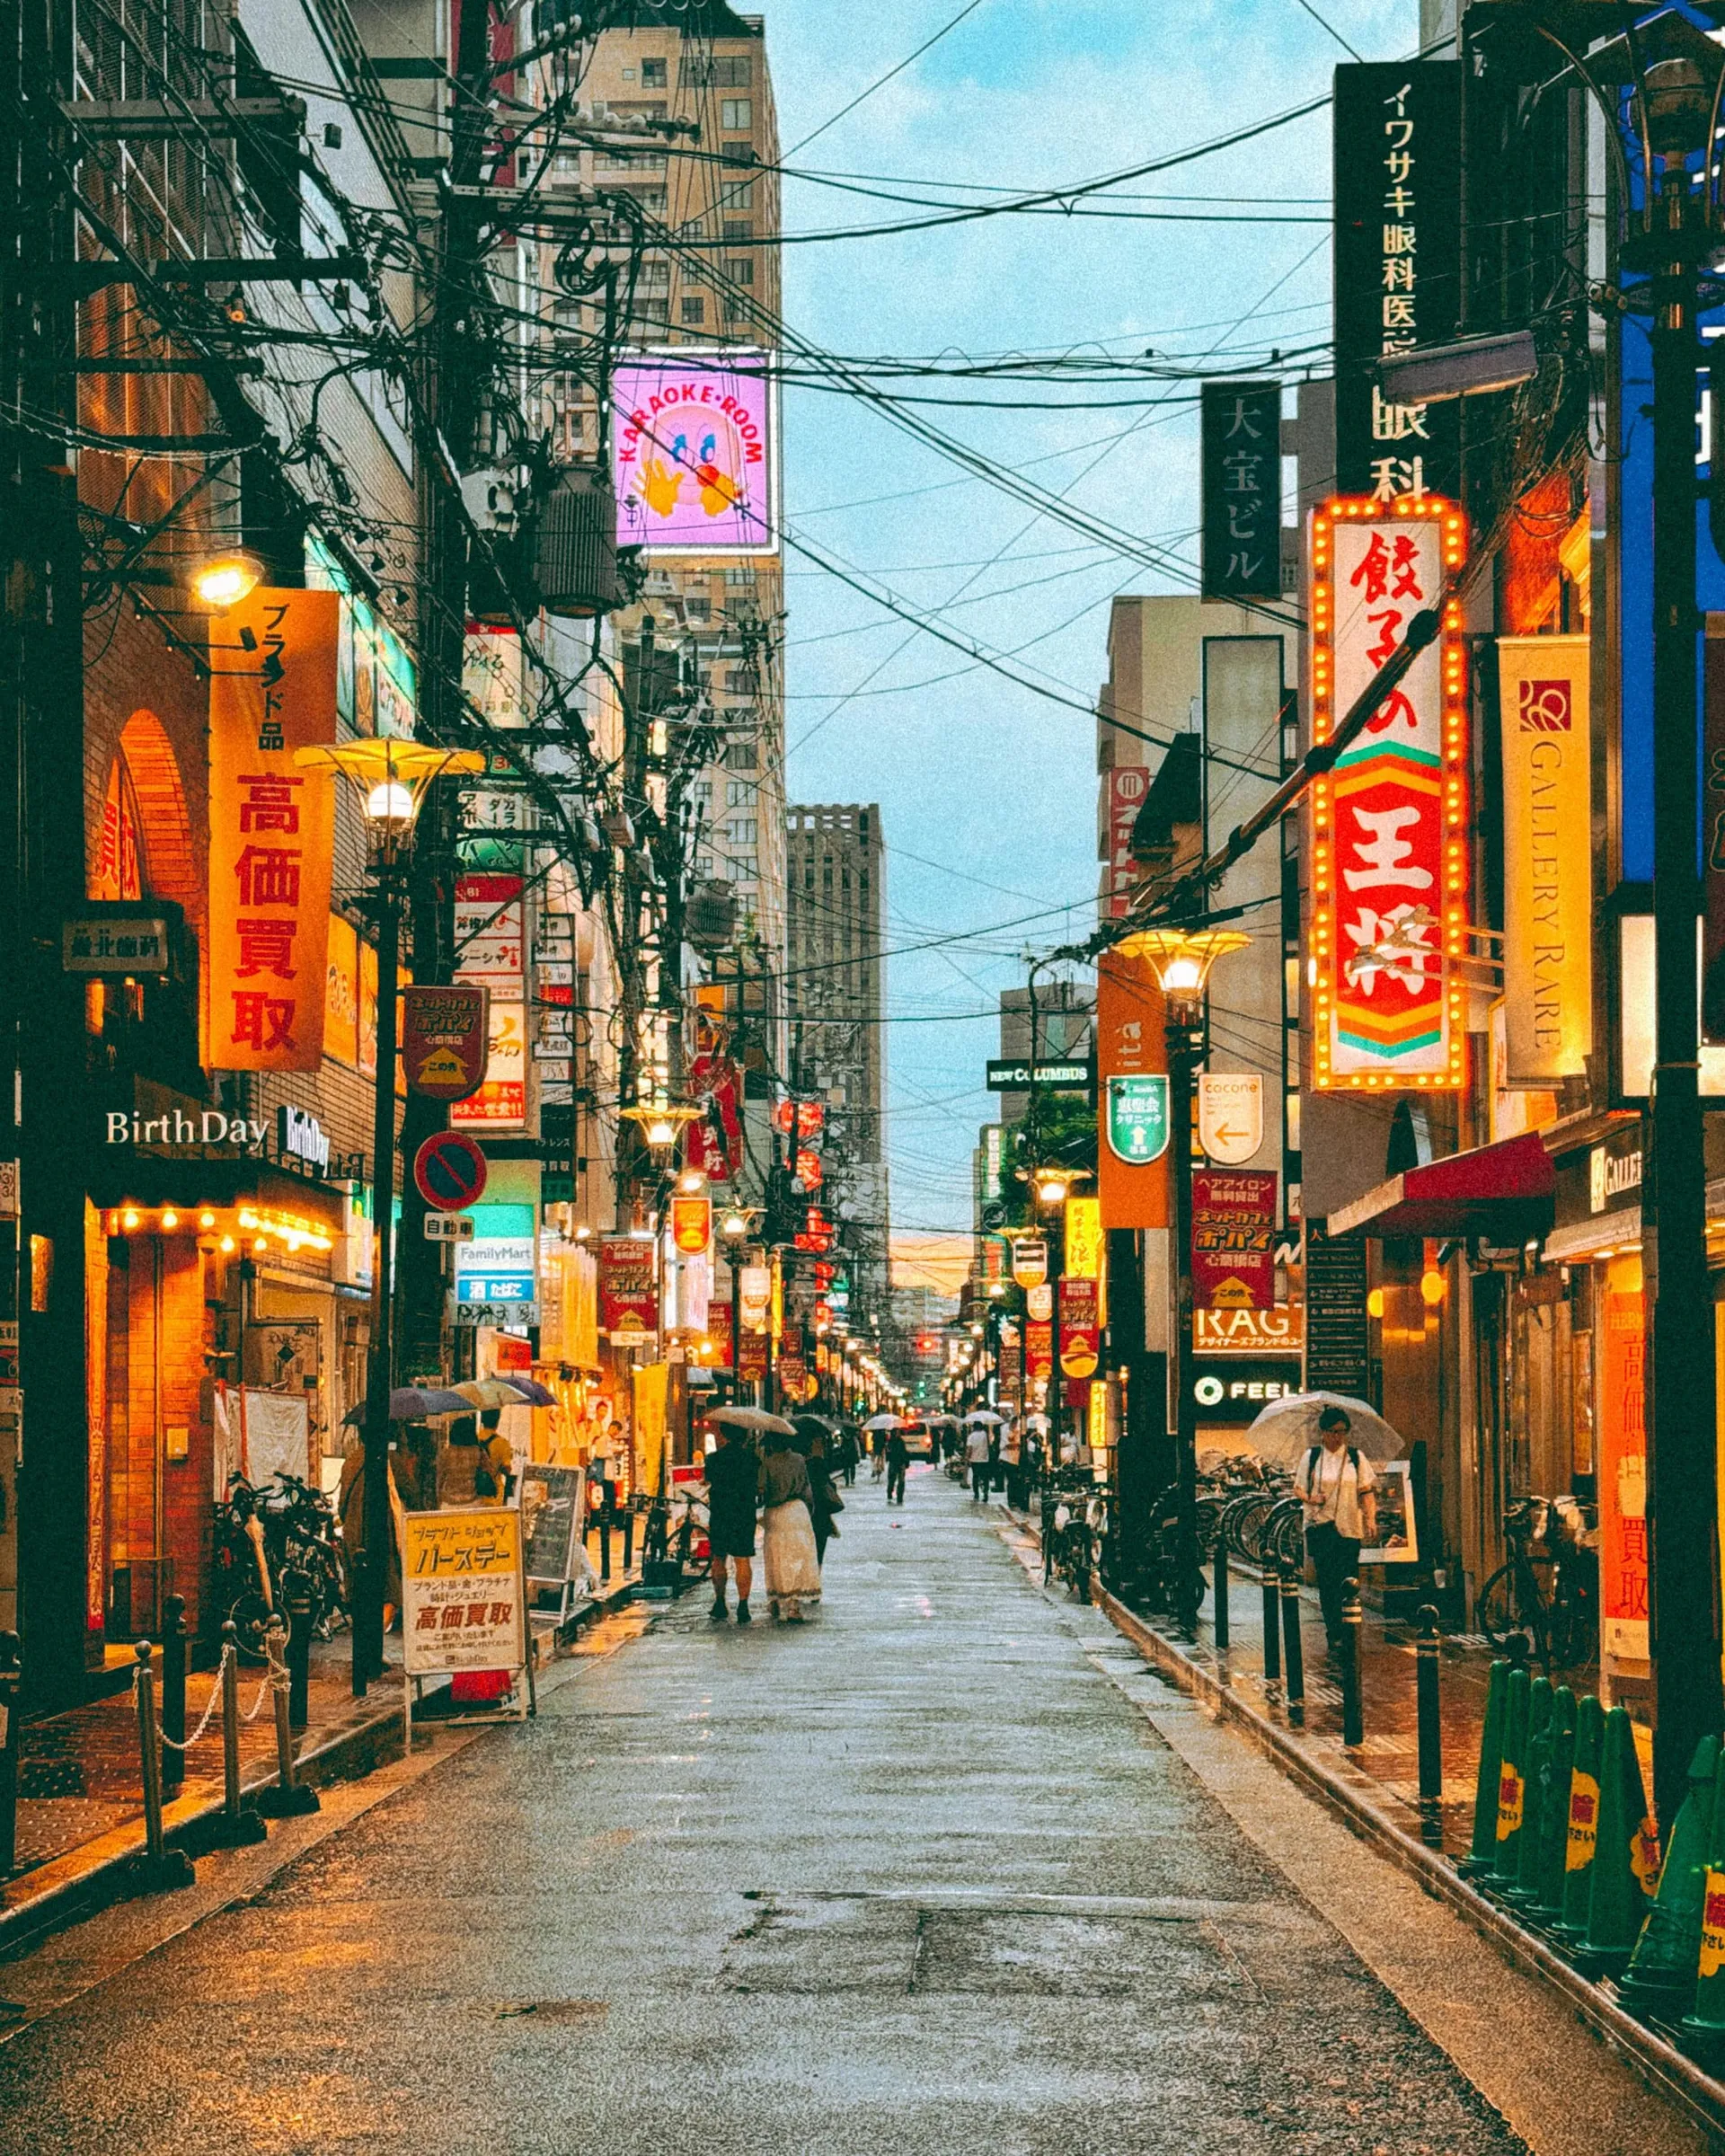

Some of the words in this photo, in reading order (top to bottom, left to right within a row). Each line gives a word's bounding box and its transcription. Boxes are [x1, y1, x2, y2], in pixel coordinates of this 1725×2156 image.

[1223, 398, 1262, 580] 大宝ビル
[1528, 739, 1562, 935] GALLERY
[234, 771, 305, 1051] 高価買取
[1533, 943, 1567, 1049] RARE
[106, 1110, 270, 1151] BirthDay
[1198, 1179, 1271, 1191] ヘアアイロン
[428, 1219, 473, 1236] 自動車
[1196, 1210, 1274, 1225] ネットカフェ
[1196, 1227, 1274, 1251] ポパイ
[461, 1247, 532, 1260] FamilyMart
[415, 1602, 513, 1630] 高価買取
